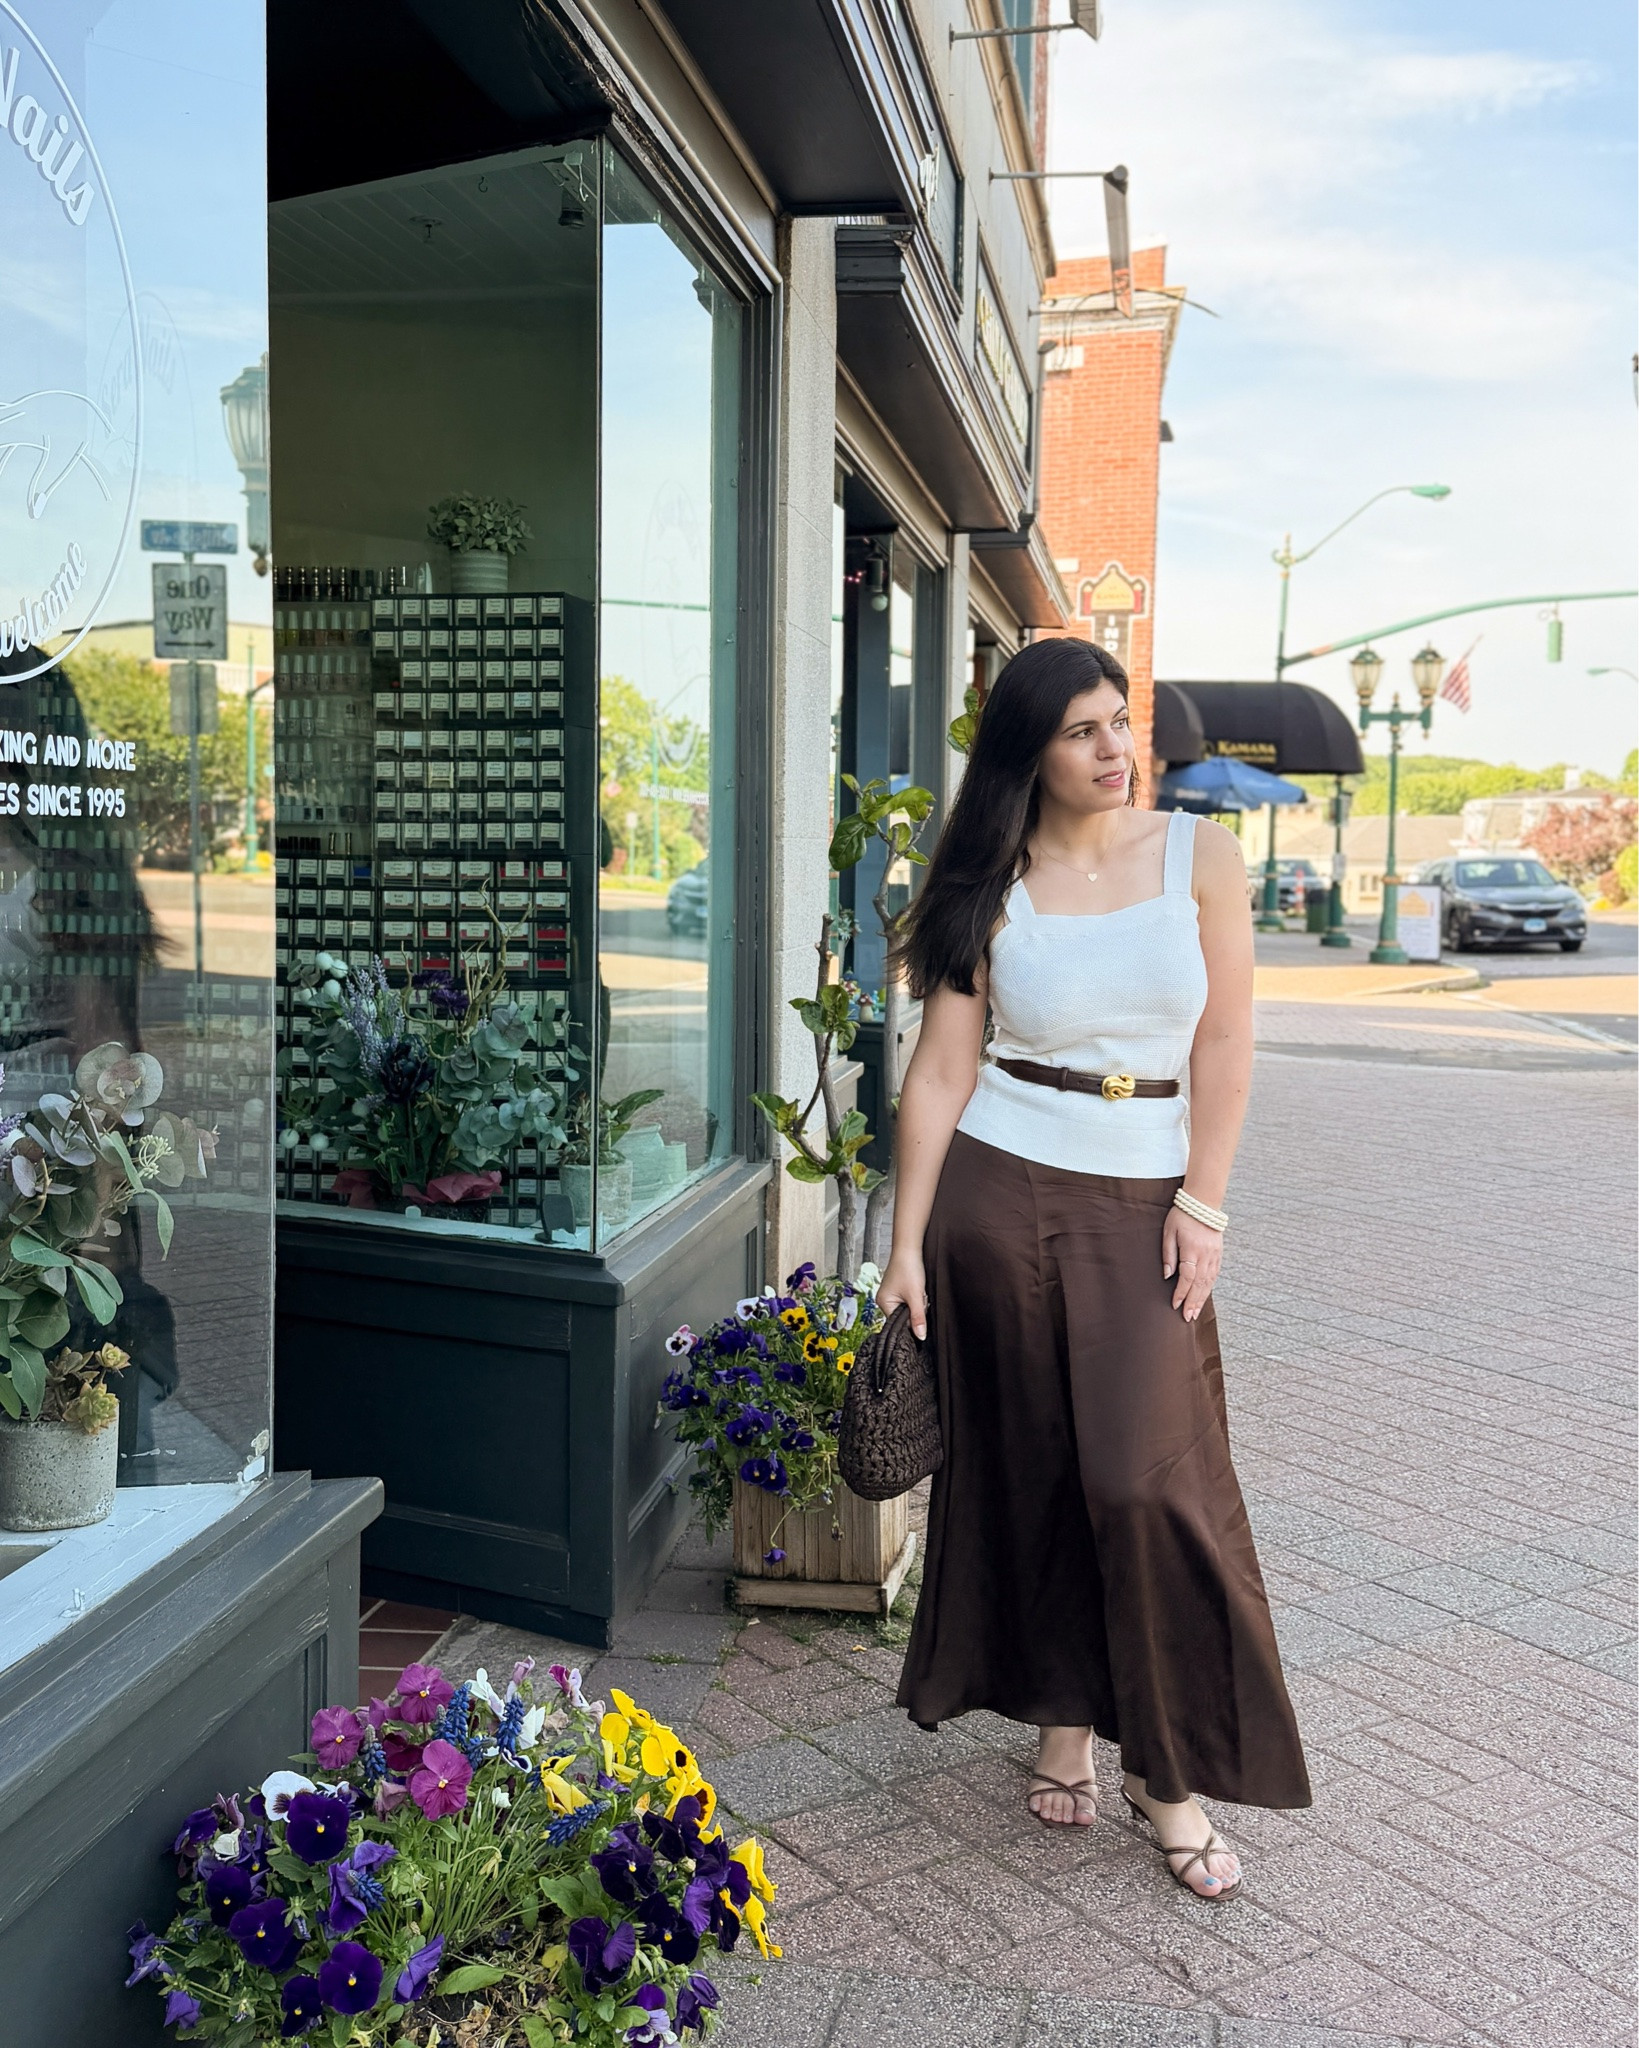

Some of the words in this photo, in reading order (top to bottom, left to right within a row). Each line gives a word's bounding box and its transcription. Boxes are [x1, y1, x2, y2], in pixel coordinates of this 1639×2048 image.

[43, 734, 81, 767] AND
[86, 738, 136, 771] MORE
[26, 783, 82, 817] SINCE
[86, 787, 126, 818] 1995
